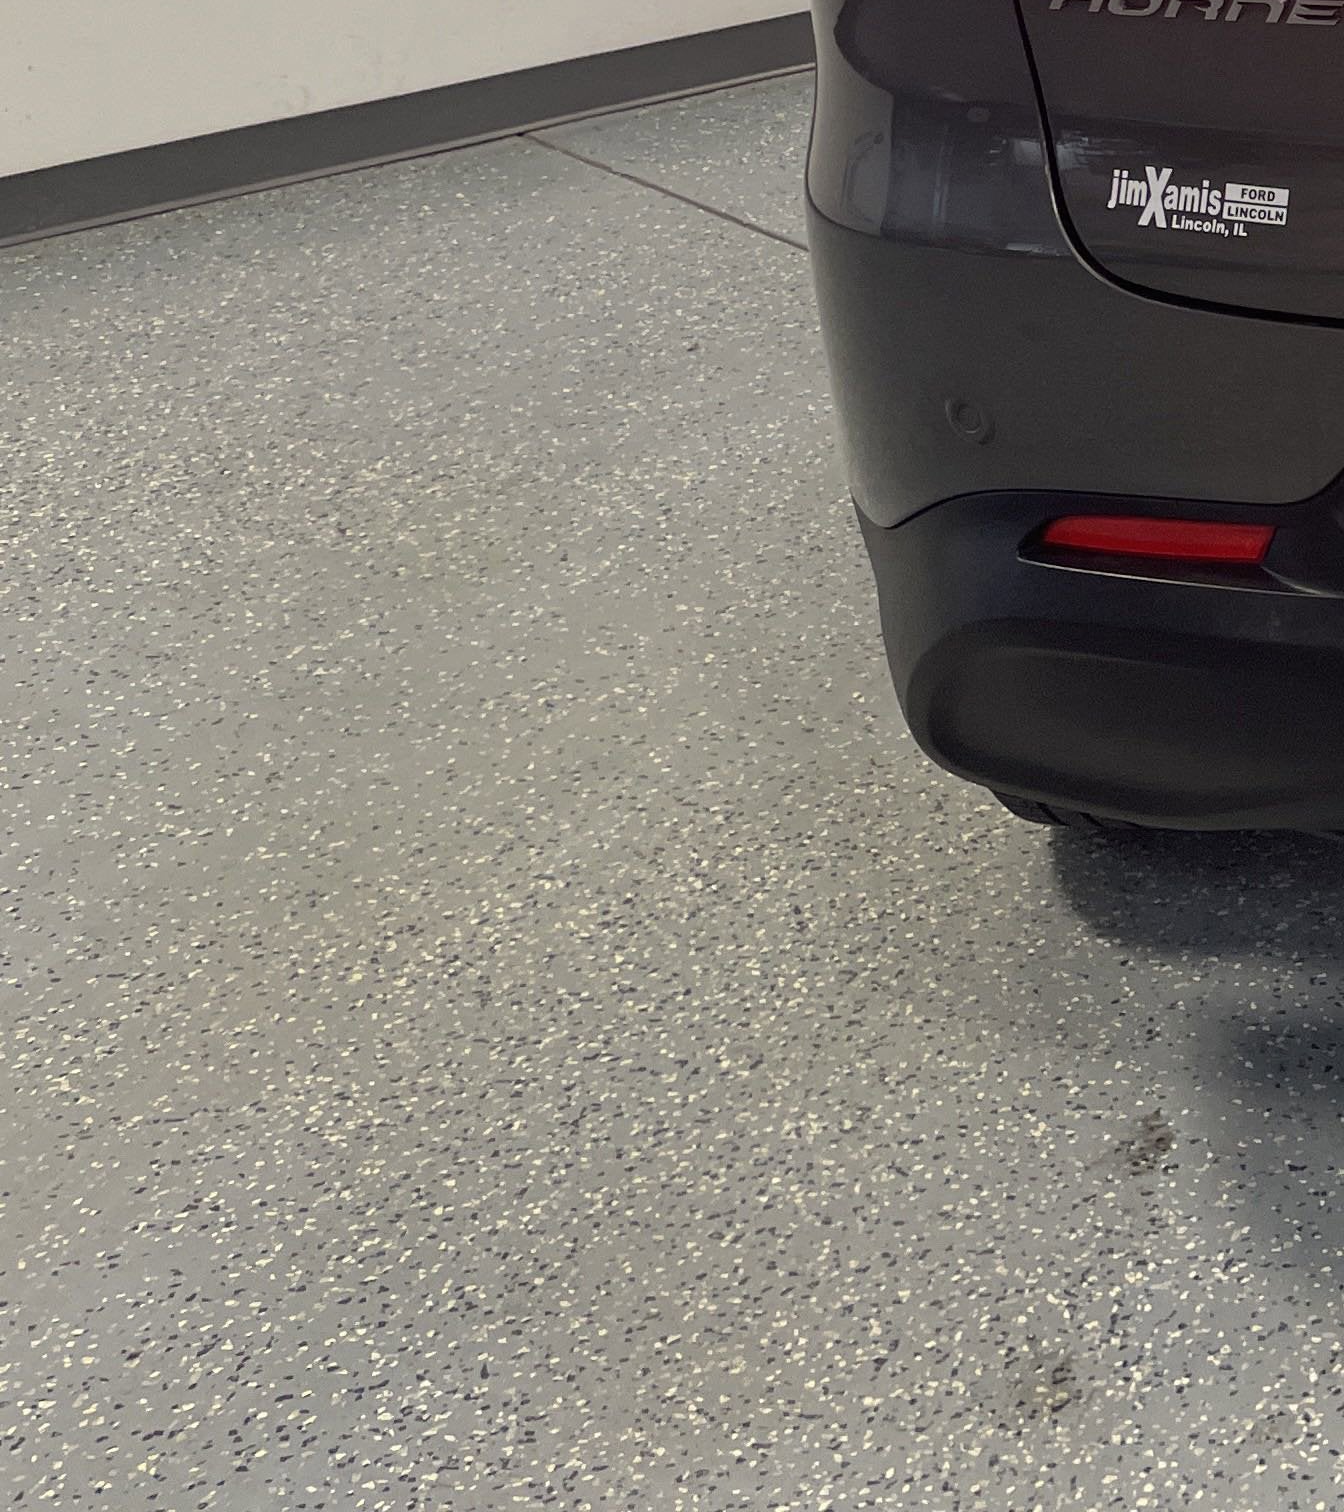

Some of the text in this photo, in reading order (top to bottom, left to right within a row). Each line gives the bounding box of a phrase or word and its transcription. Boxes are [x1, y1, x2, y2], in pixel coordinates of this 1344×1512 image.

[1240, 188, 1275, 201] FORD
[1227, 206, 1284, 222] LINCOLN
[1171, 214, 1247, 237] Lincoln, IL
